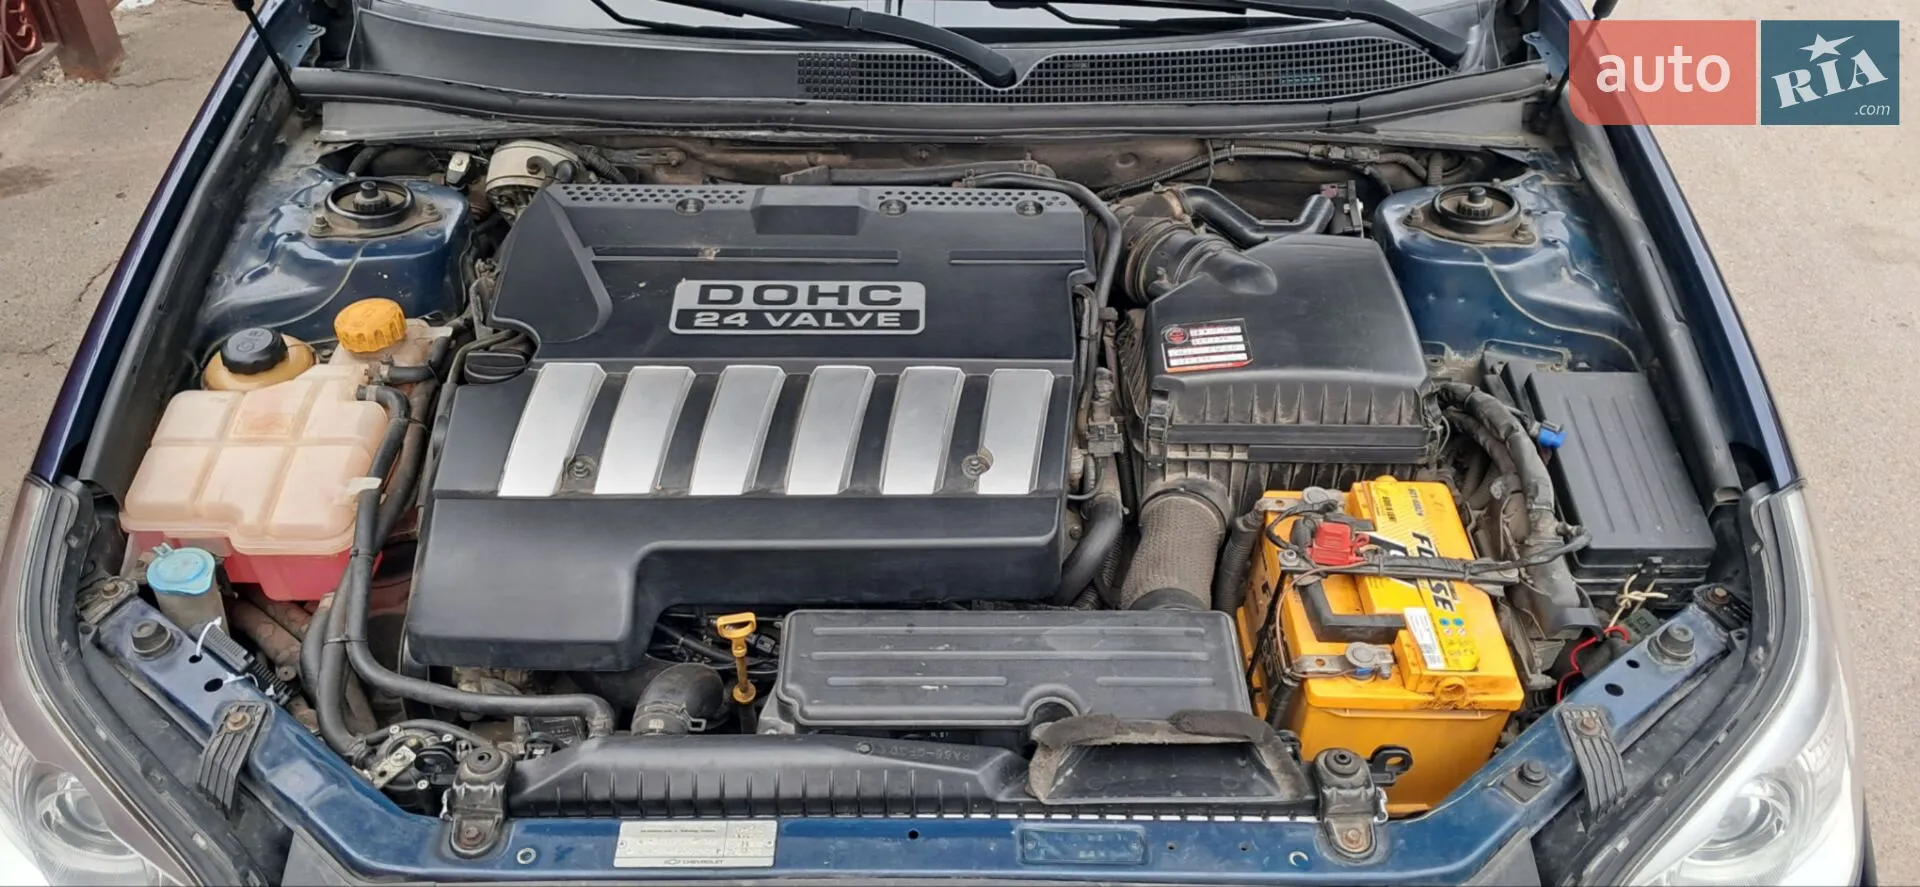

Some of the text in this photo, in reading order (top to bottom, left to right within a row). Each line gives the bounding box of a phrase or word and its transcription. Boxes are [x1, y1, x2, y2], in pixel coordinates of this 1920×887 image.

[697, 284, 902, 306] DOHC
[693, 312, 901, 327] 24 VALVE
